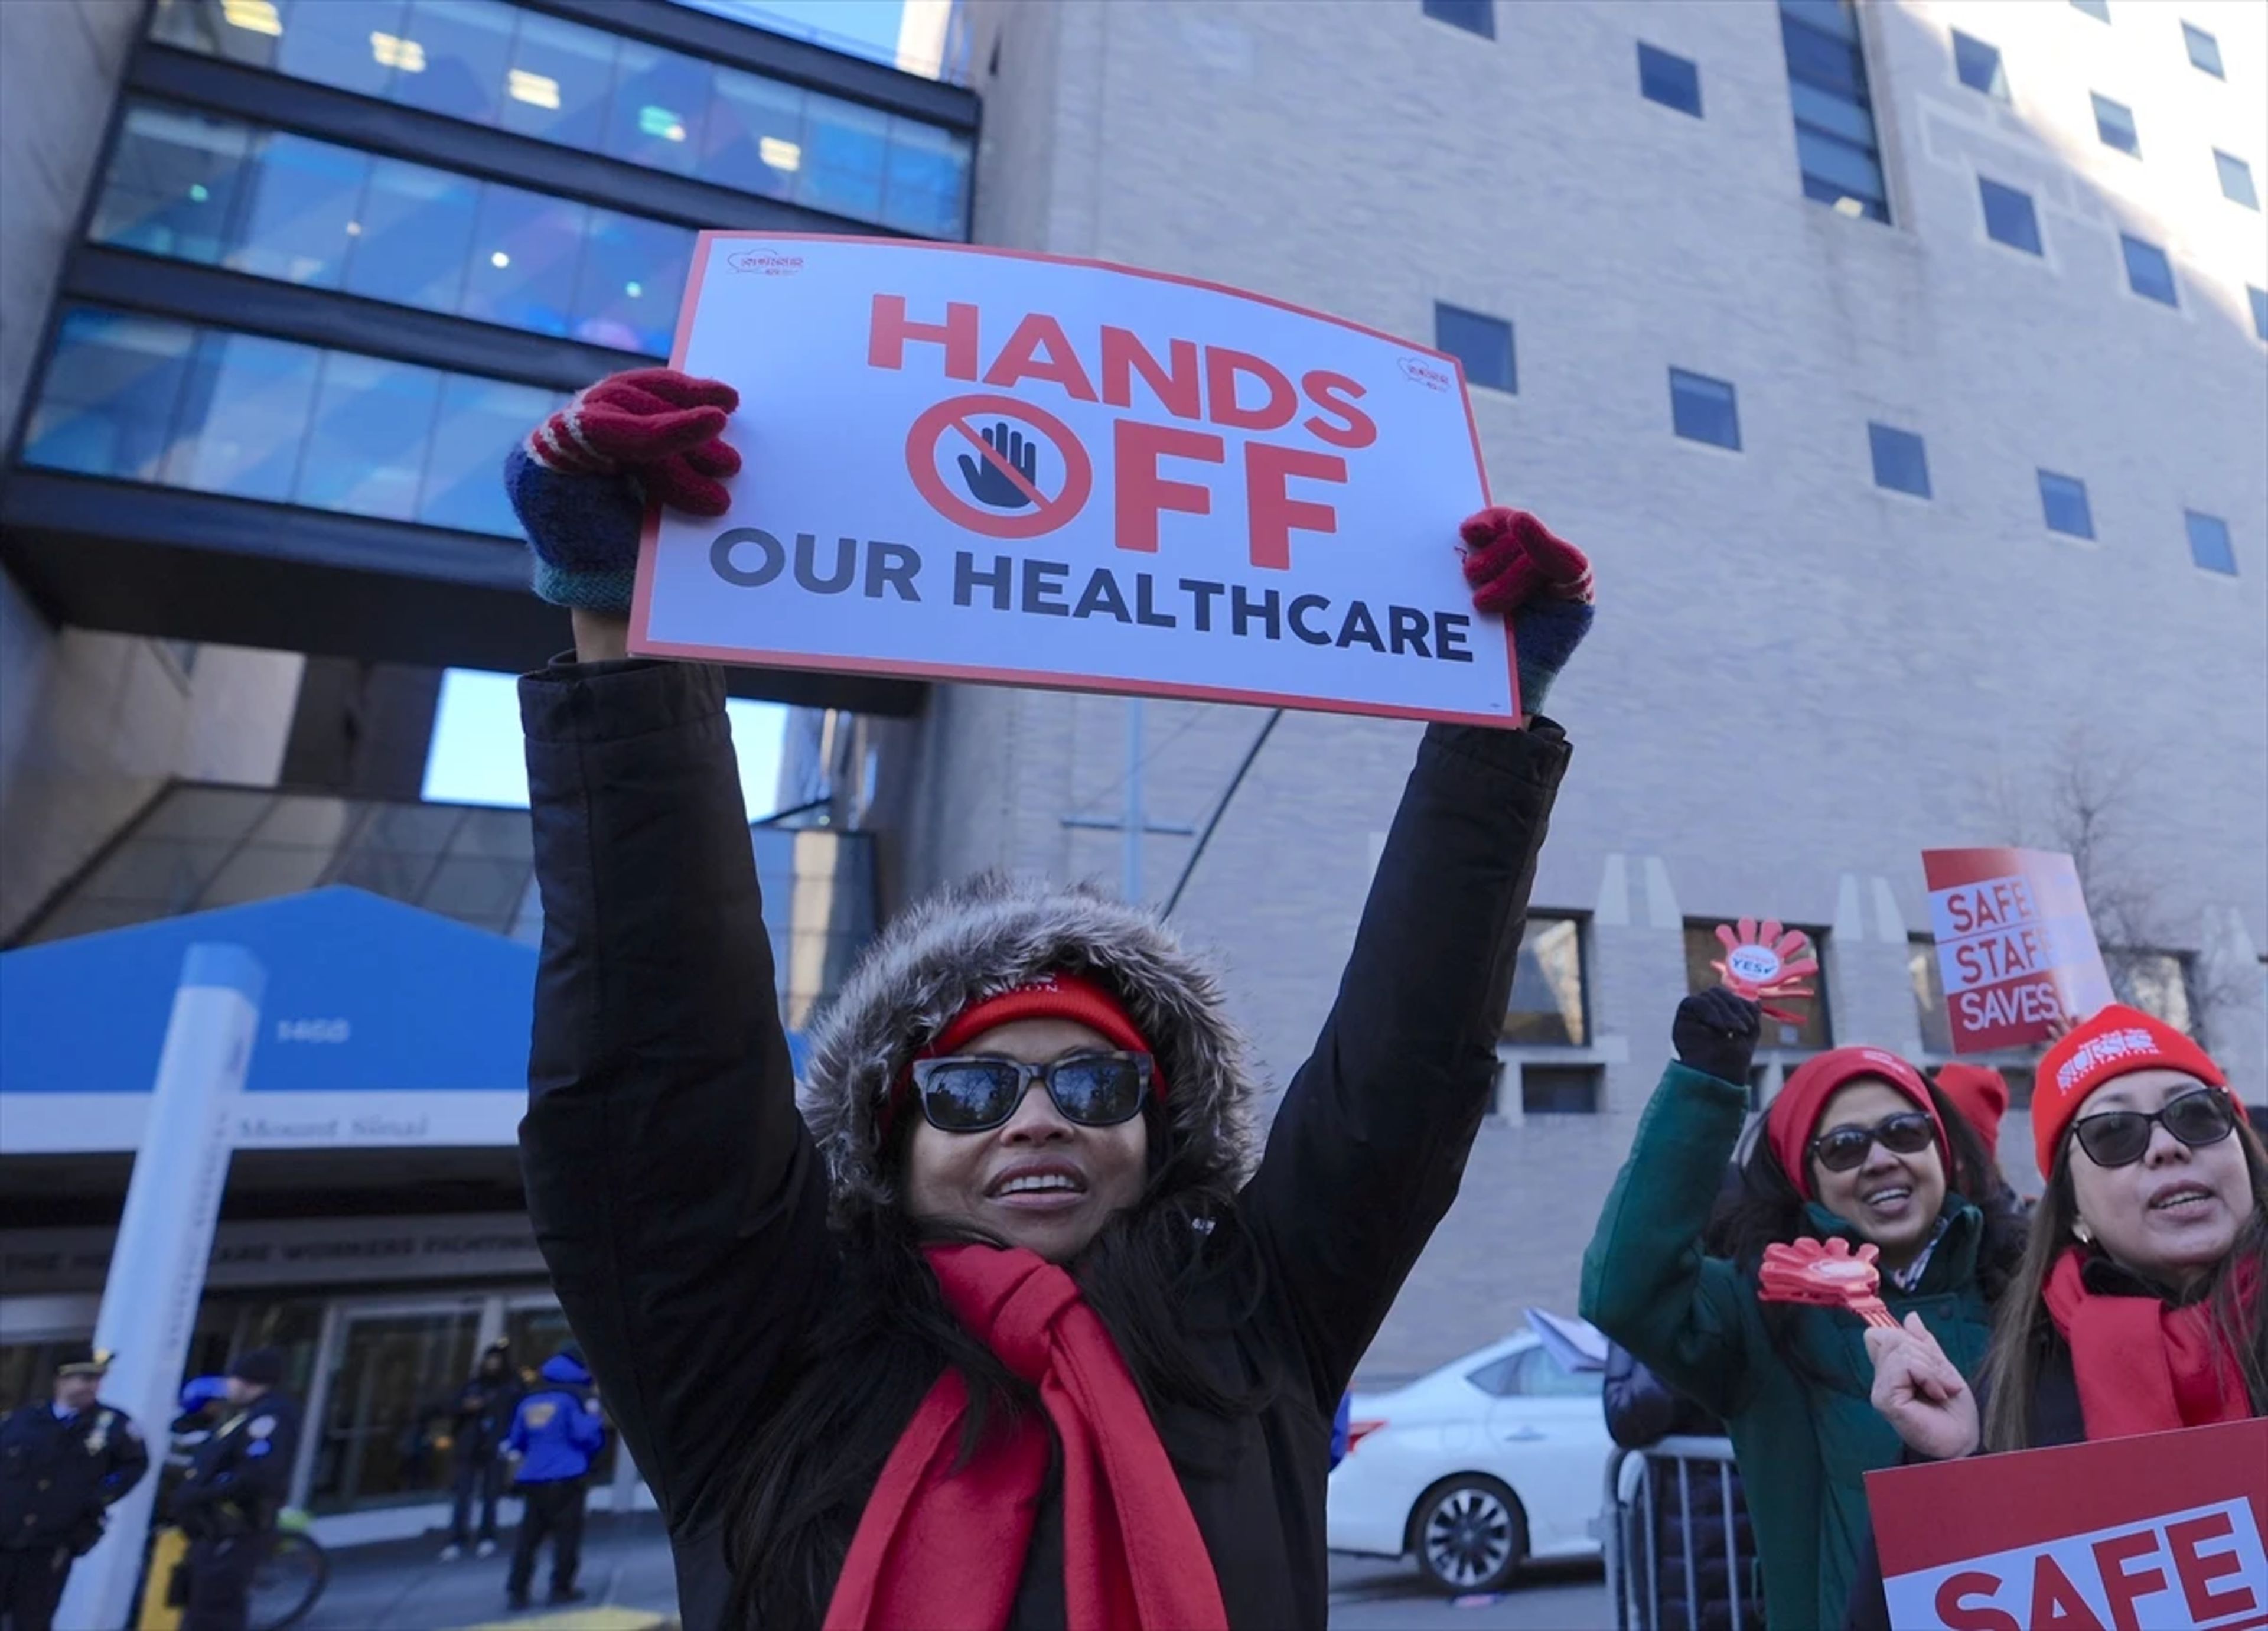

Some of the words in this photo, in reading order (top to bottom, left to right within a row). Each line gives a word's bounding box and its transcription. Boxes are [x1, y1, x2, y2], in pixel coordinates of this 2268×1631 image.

[868, 294, 1377, 449] HANDS
[905, 394, 1348, 571] OFF
[709, 527, 922, 603] OUR
[953, 551, 1474, 663] HEALTHCARE
[1732, 958, 1762, 974] YES
[1947, 882, 2031, 932] SAFE
[1960, 982, 2058, 1031] SAVES
[1935, 1511, 2257, 1631] SAFE
